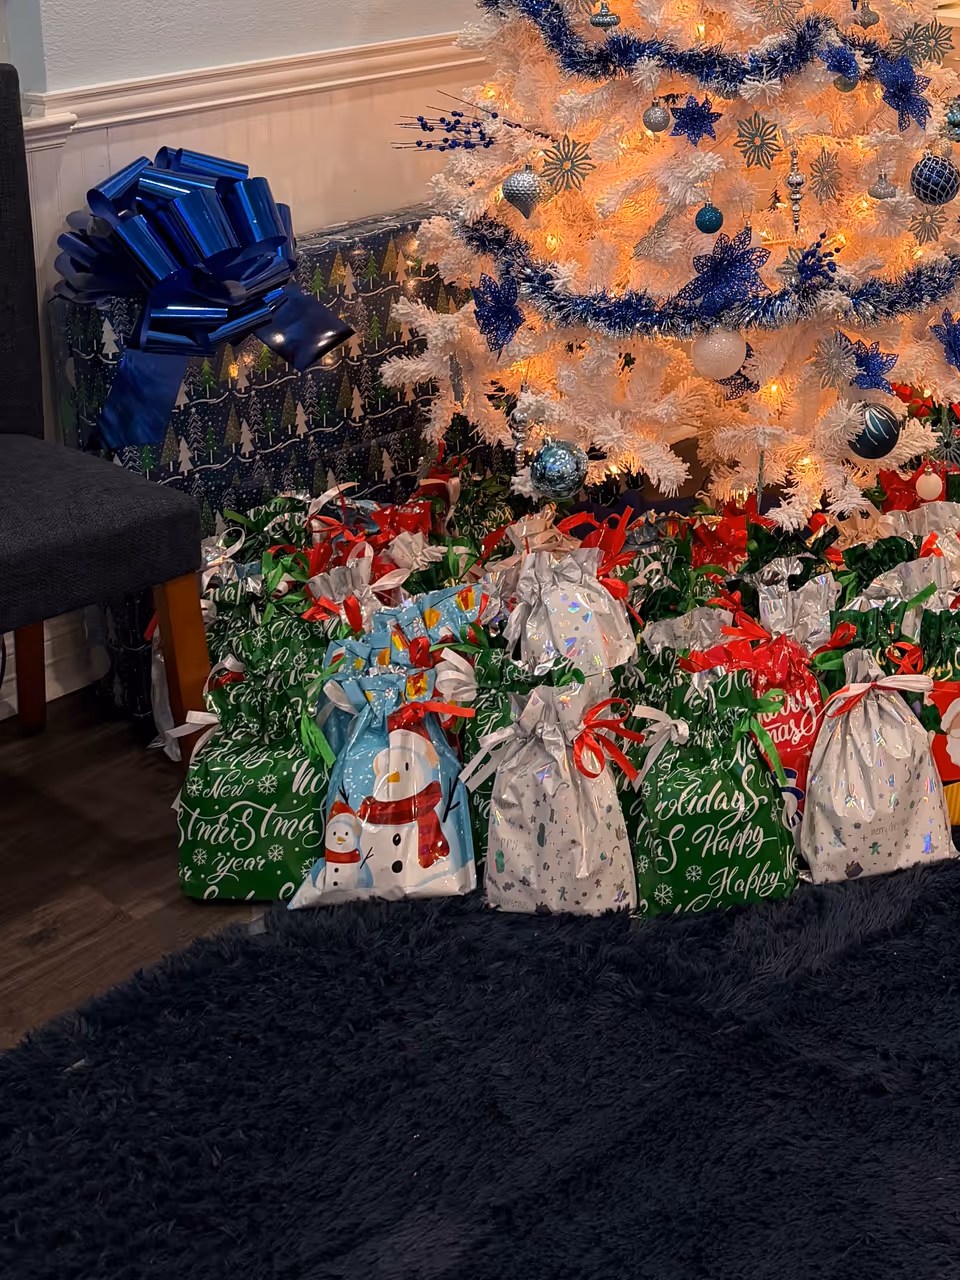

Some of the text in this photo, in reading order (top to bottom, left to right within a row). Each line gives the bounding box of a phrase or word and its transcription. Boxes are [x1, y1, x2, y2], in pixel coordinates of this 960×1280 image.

[202, 770, 255, 799] New
[691, 822, 778, 859] Happy
[206, 853, 266, 884] year
[708, 861, 786, 900] Happy
